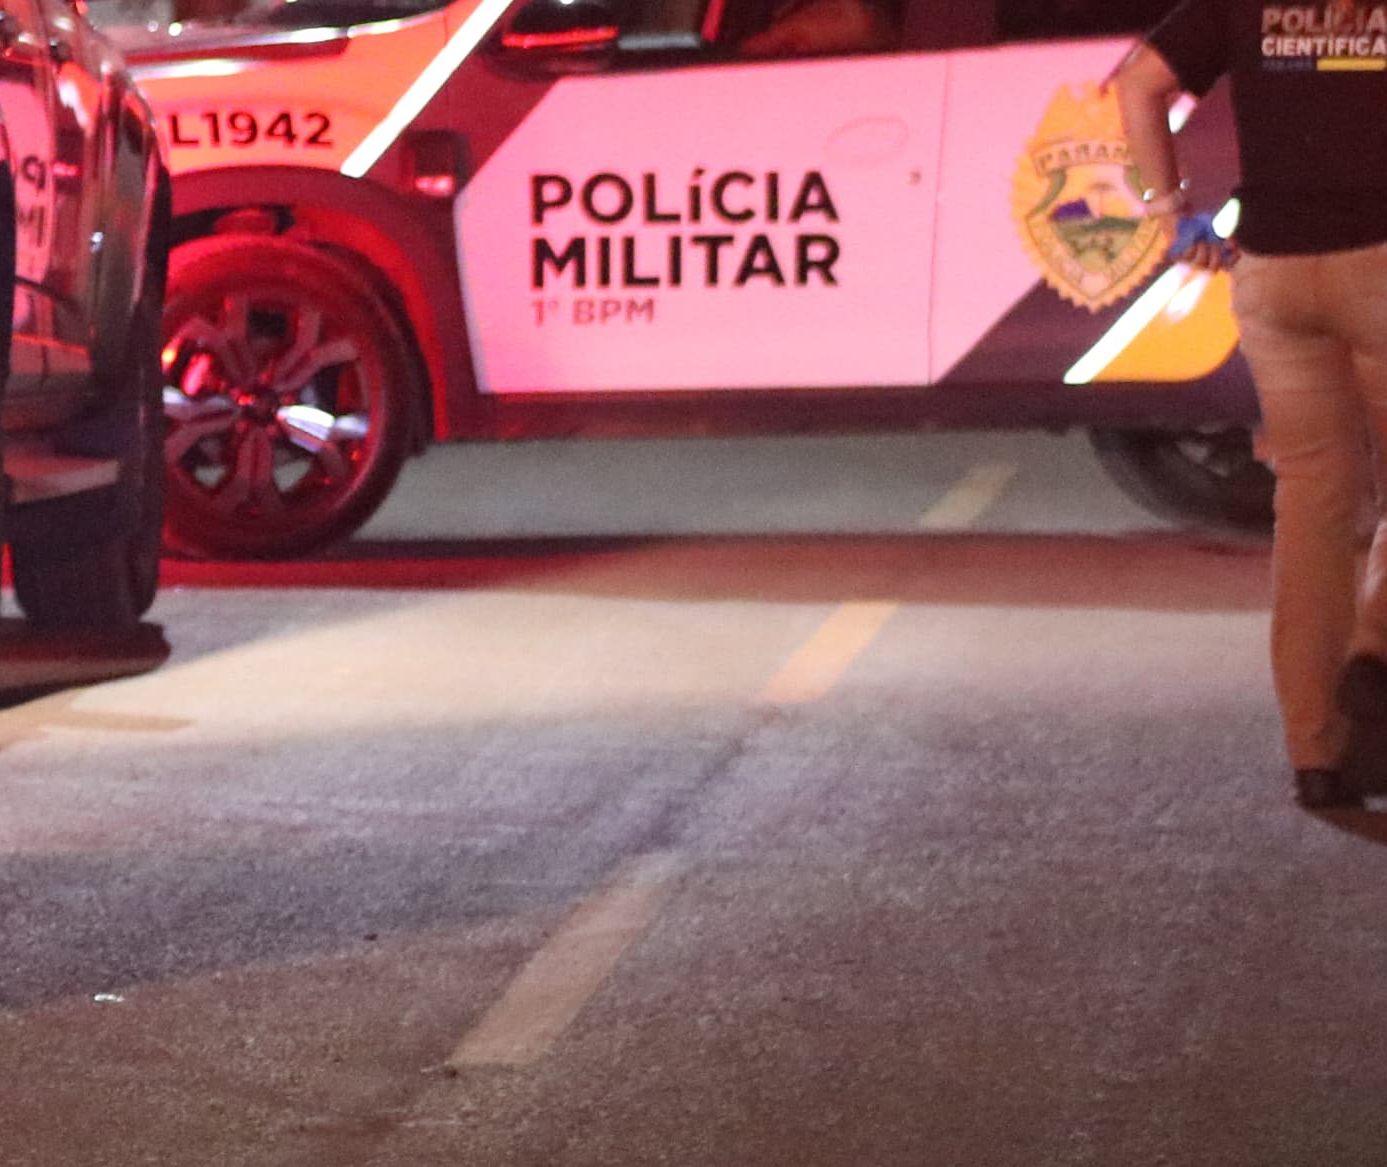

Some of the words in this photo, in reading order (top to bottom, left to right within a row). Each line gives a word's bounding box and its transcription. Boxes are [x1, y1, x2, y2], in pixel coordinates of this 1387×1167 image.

[168, 111, 333, 148] L1942
[530, 167, 840, 225] POLÍCIA
[530, 233, 840, 289] MILITAR
[572, 297, 656, 325] BPM
